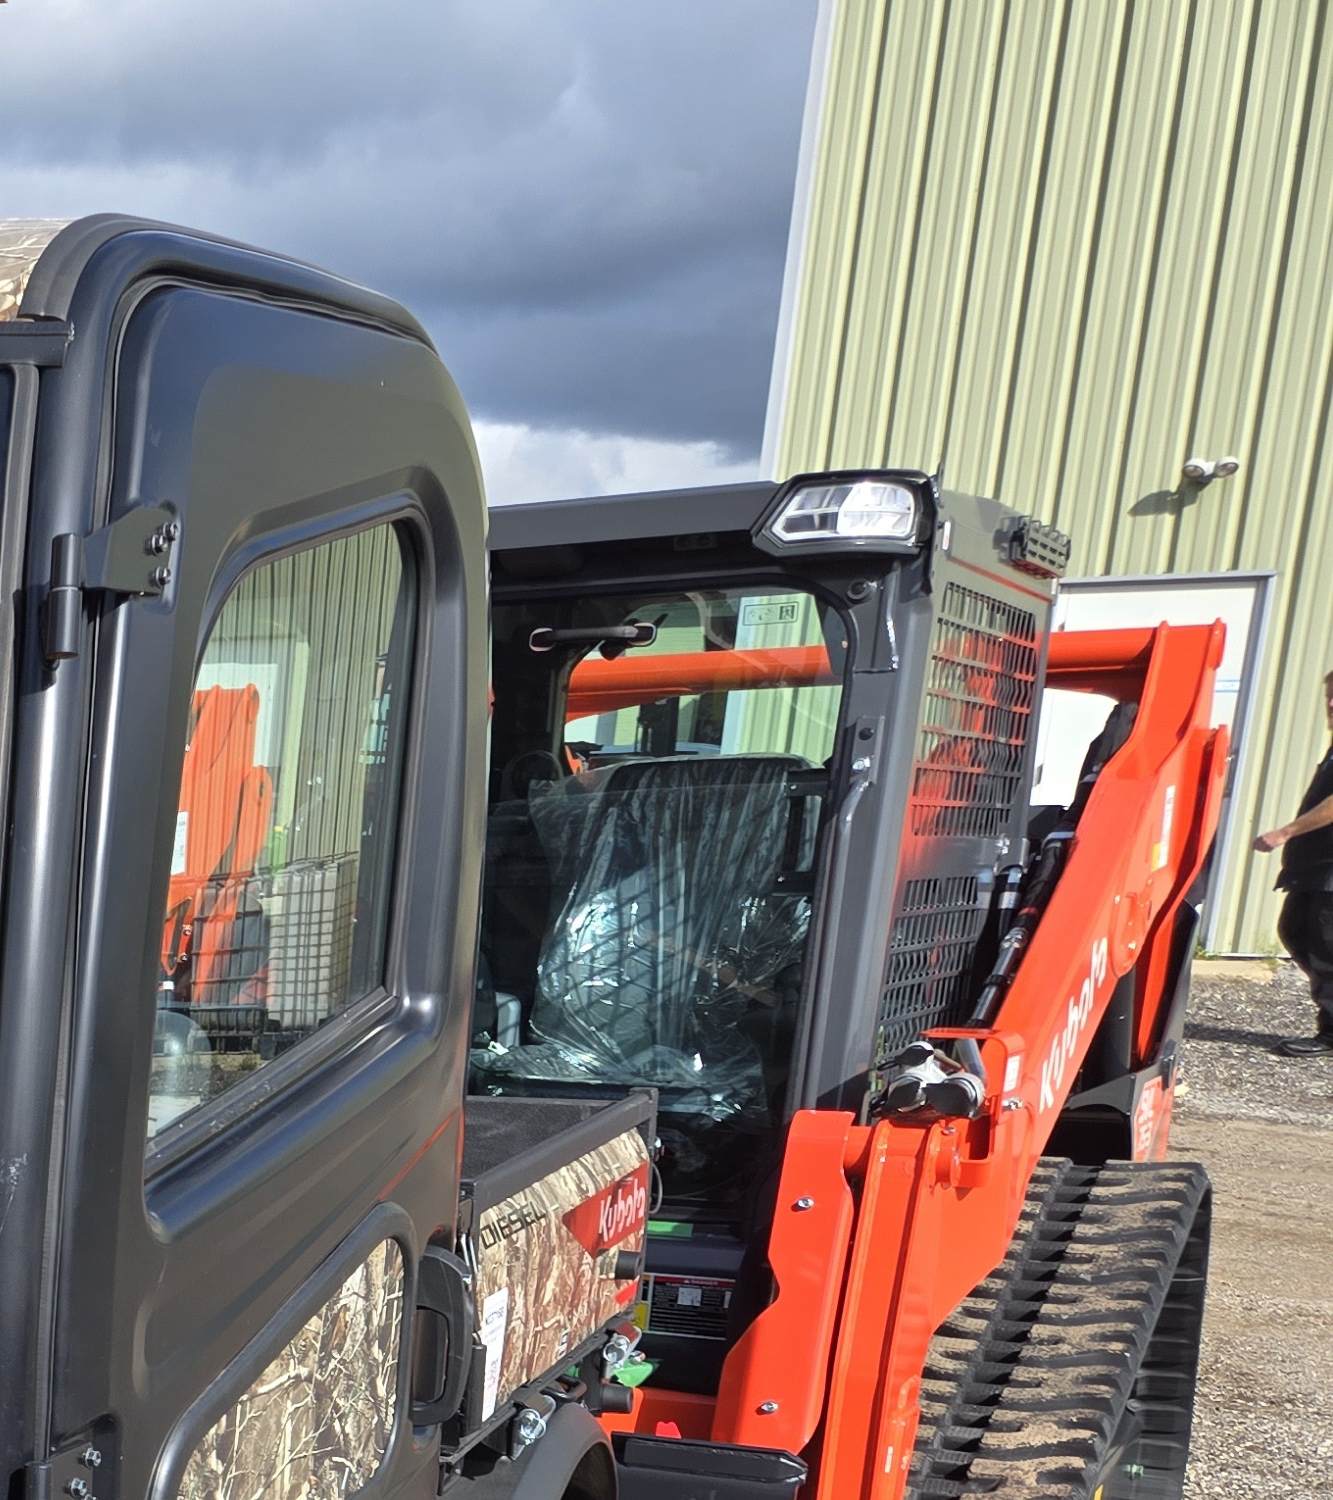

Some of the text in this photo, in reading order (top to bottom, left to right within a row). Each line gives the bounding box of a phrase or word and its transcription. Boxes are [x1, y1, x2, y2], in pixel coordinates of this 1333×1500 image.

[1039, 937, 1108, 1114] Kubota
[480, 1203, 547, 1250] DIESEL
[598, 1178, 646, 1243] Kubota
